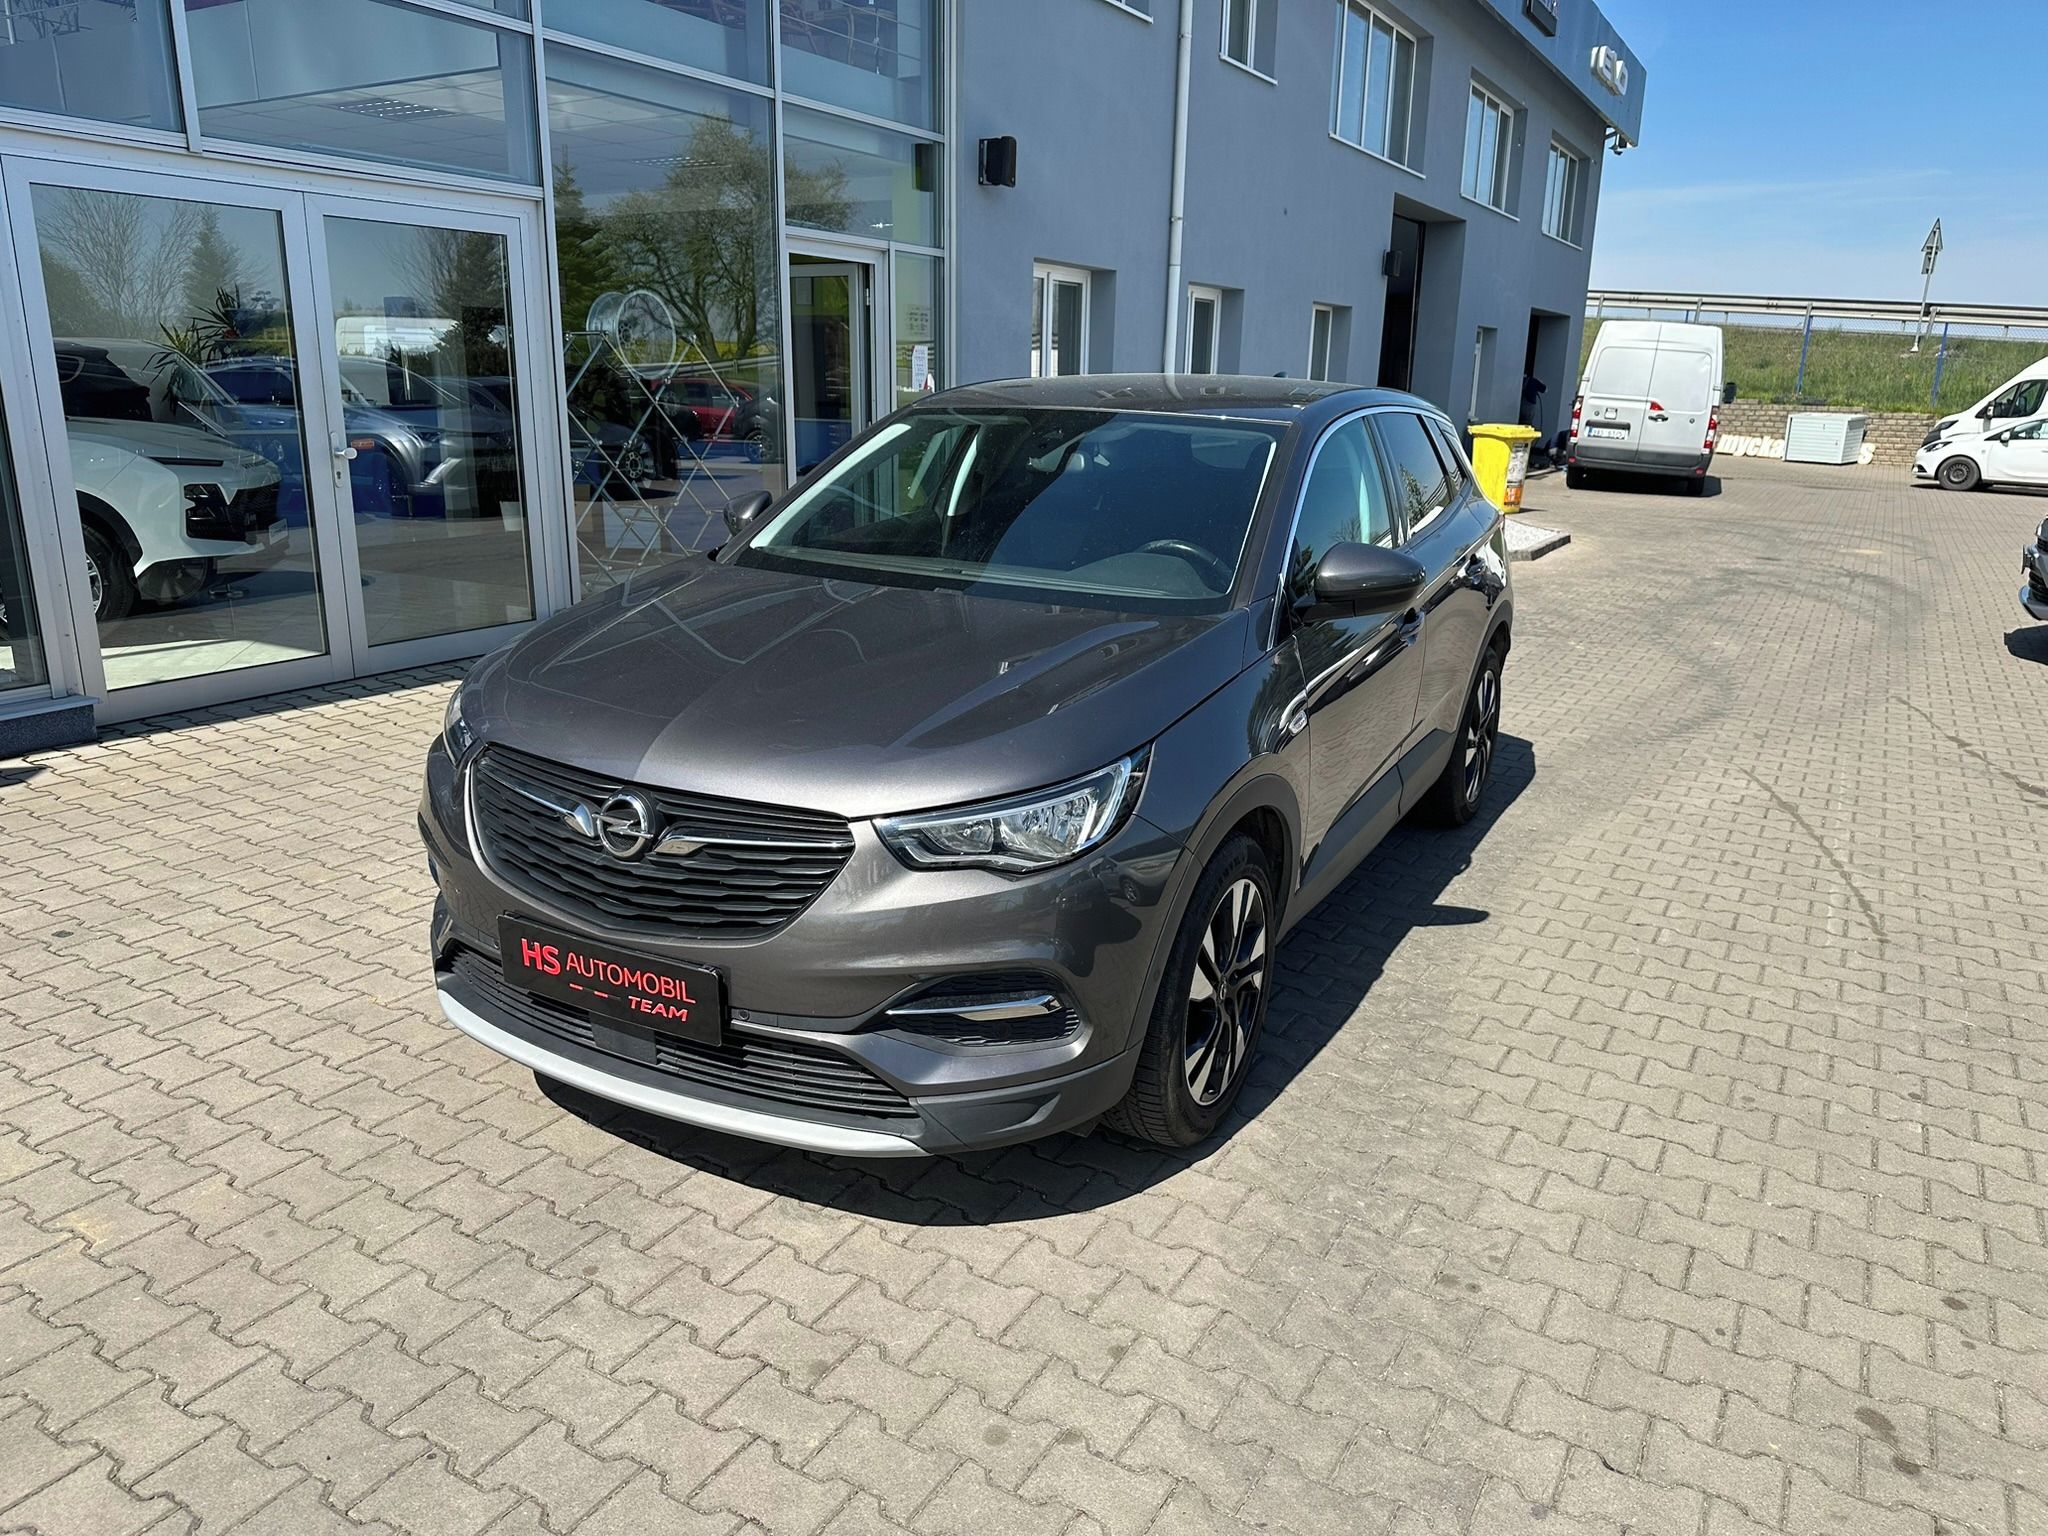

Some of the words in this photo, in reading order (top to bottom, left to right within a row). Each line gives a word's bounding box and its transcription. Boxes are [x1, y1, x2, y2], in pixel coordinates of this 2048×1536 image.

[521, 938, 561, 975] HS
[566, 952, 696, 1004] AUTOMOBIL
[628, 995, 689, 1022] TEAM
